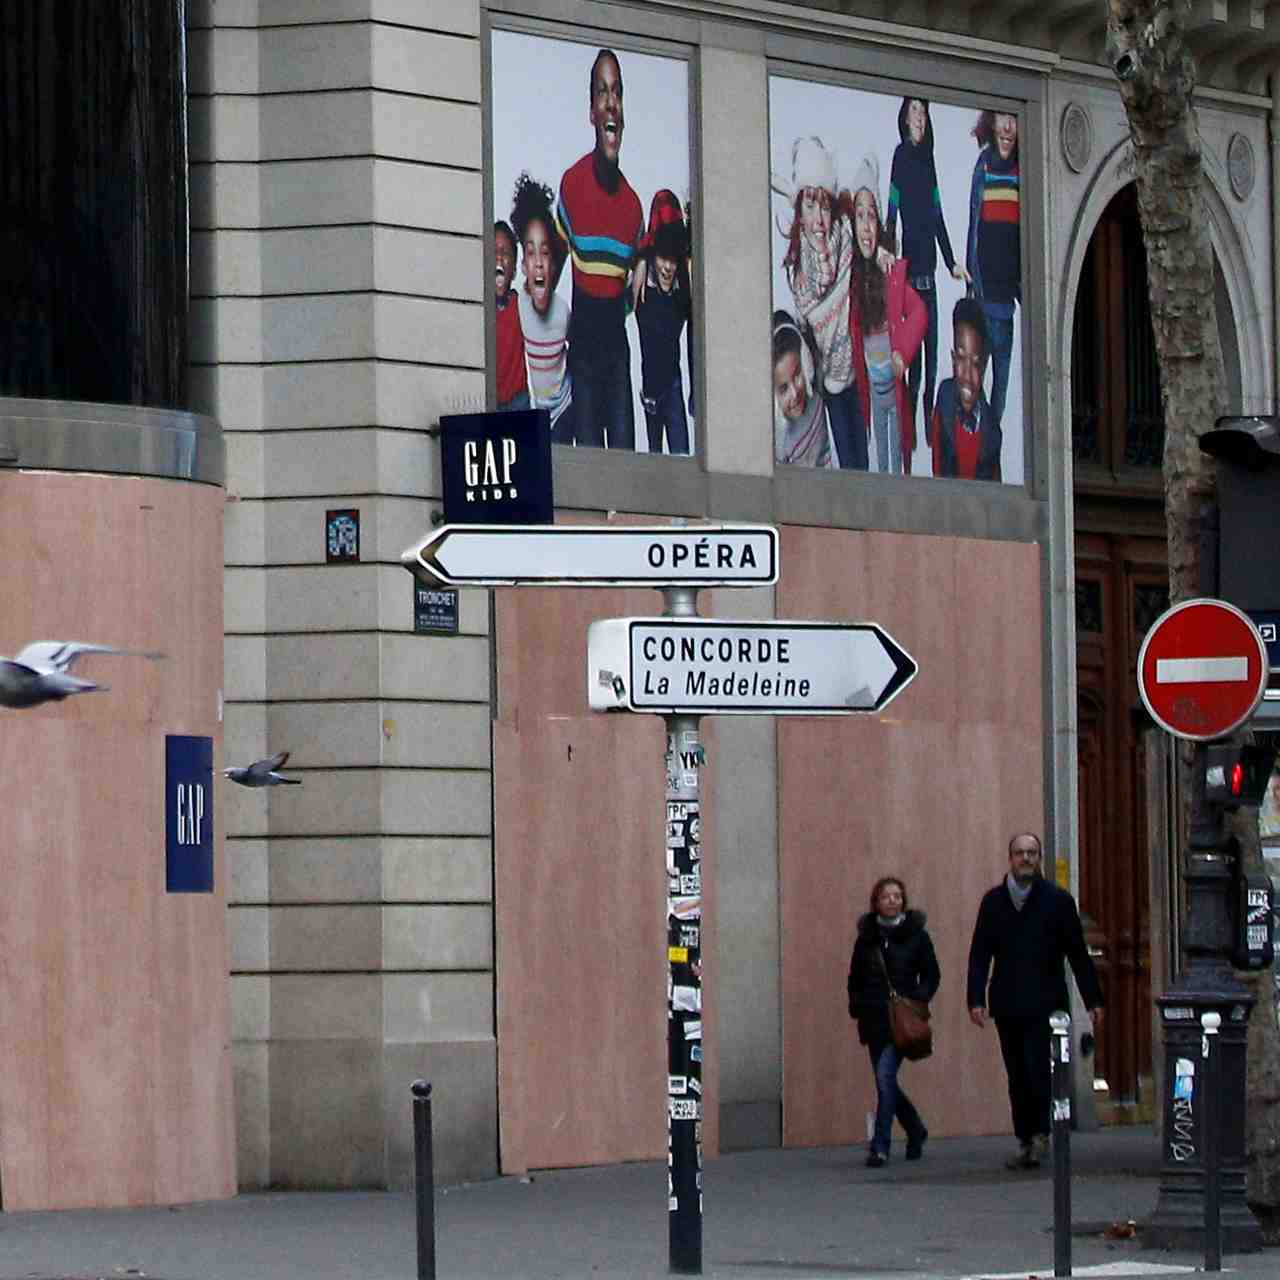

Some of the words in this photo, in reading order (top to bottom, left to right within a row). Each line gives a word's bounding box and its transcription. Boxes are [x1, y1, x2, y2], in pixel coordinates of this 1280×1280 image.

[464, 438, 517, 487] GAP
[466, 488, 518, 502] KIDS
[647, 537, 757, 569] OPÉRA
[642, 636, 790, 663] CONCORDE
[644, 670, 670, 695] La
[685, 670, 811, 697] Madeleine
[176, 783, 204, 845] GAP
